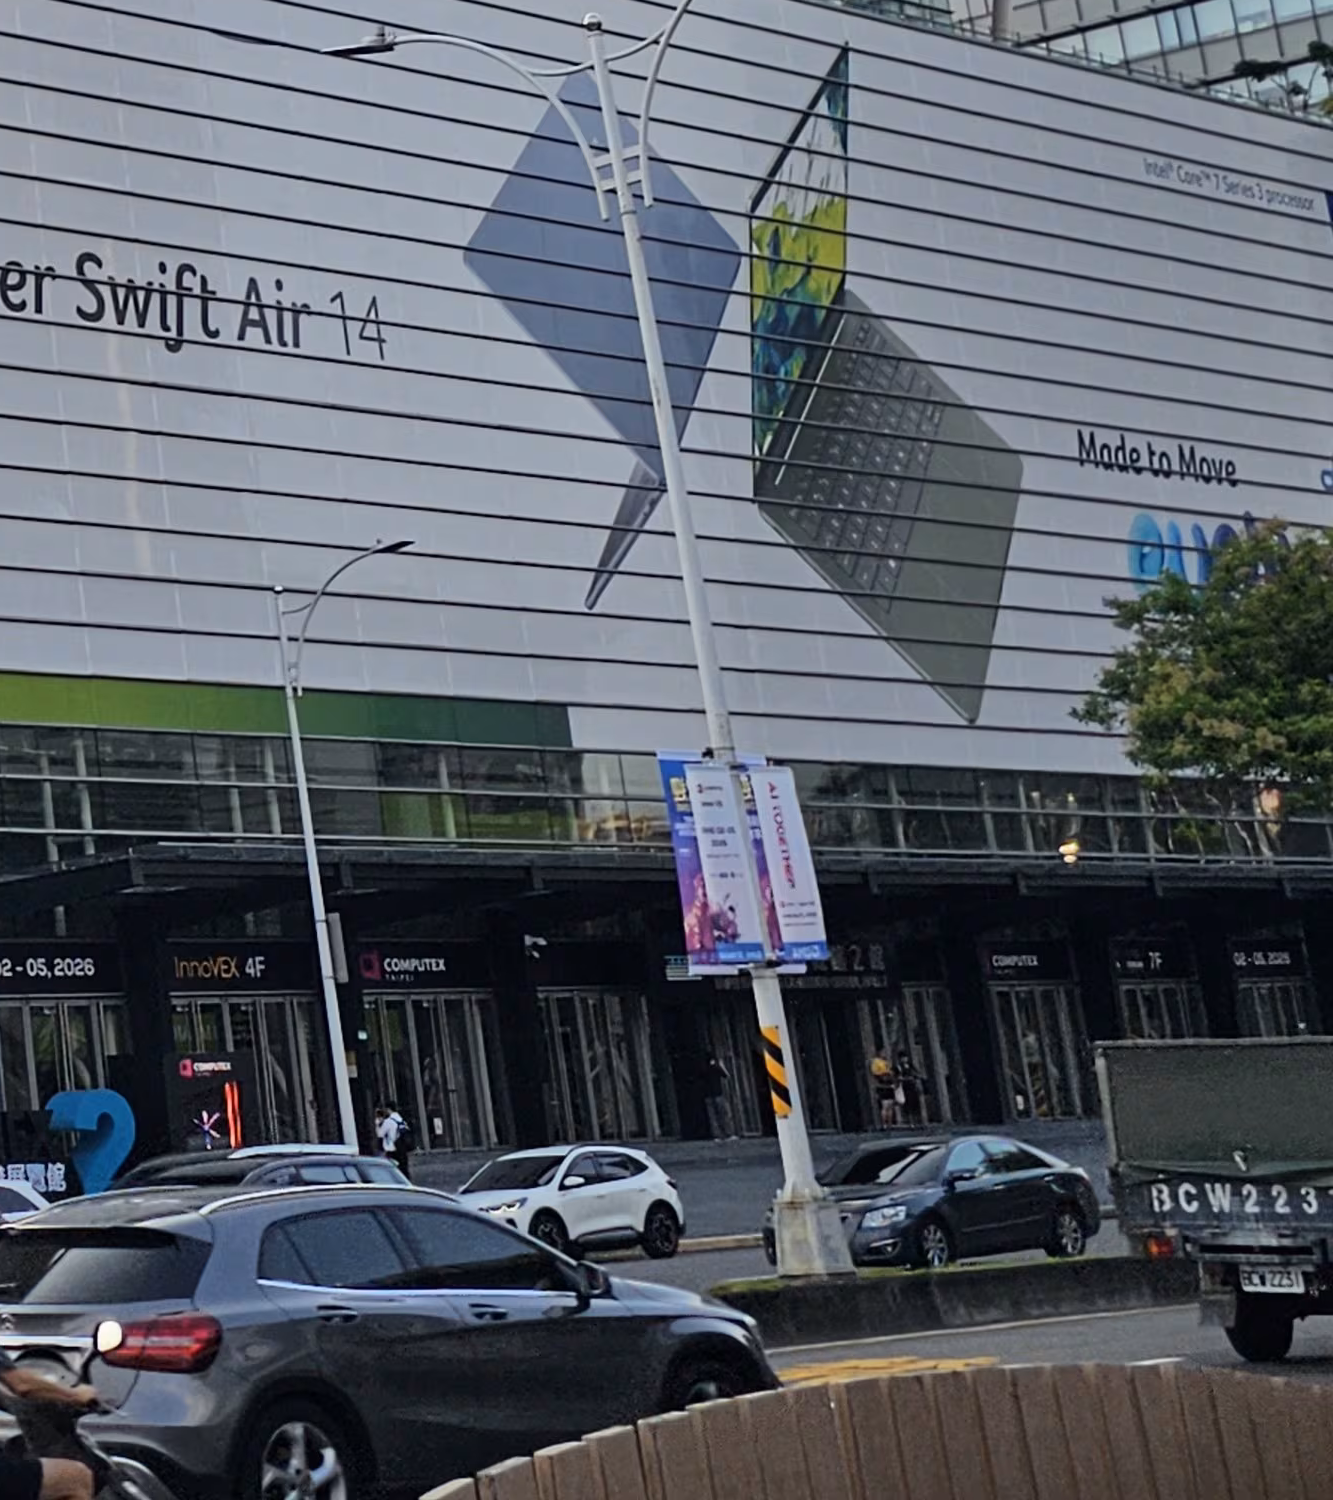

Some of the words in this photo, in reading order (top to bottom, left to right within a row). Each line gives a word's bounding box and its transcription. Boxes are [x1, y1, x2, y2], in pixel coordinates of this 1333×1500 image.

[1221, 177, 1255, 200] Series
[74, 252, 221, 353] Swift
[237, 277, 311, 349] Air
[329, 291, 388, 361] 14
[1077, 428, 1143, 475] Made
[1147, 441, 1173, 479] to
[1177, 443, 1239, 488] Move
[26, 957, 52, 979] 05,
[53, 957, 96, 977] 2026
[174, 956, 240, 979] InnoVEX
[245, 956, 266, 979] 4F
[383, 957, 446, 972] COMPUTEX
[992, 954, 1039, 967] COMPUTEX
[45, 1088, 135, 1198] 2
